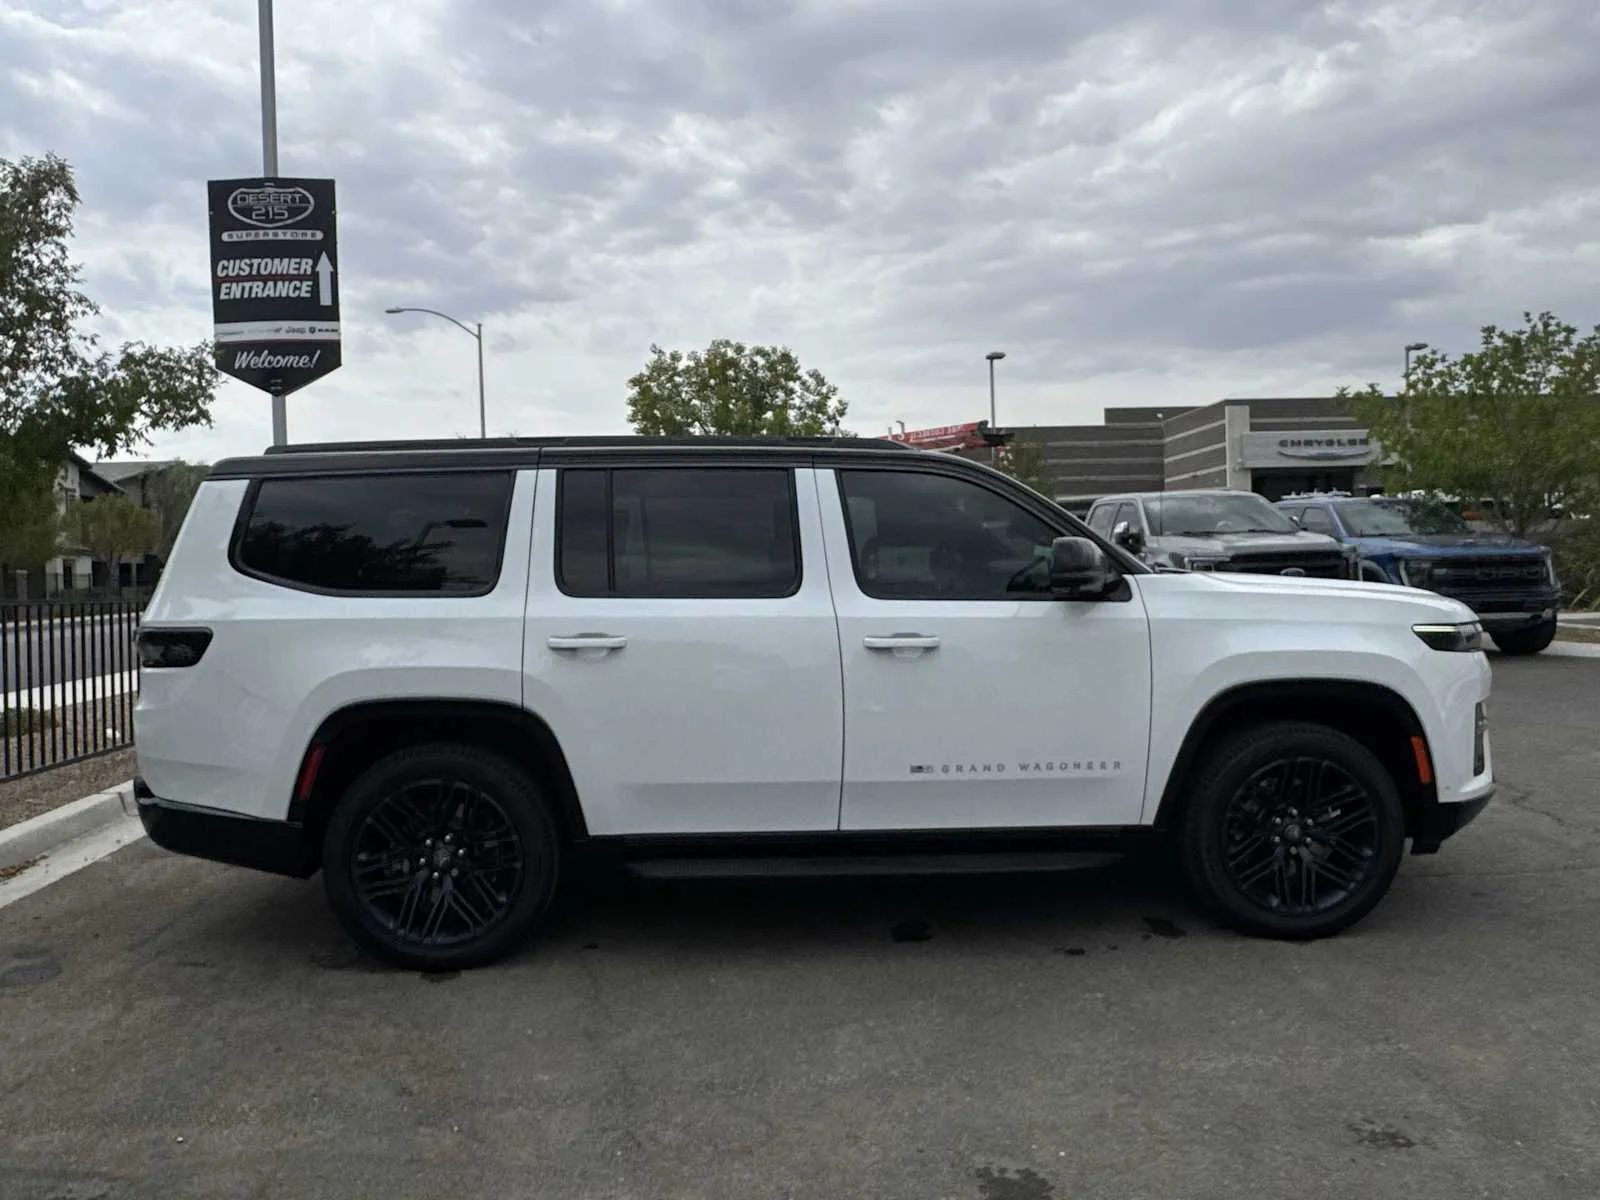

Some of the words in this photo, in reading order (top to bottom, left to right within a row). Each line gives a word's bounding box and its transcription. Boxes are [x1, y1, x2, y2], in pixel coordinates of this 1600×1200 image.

[236, 193, 303, 205] DESERT
[252, 206, 288, 220] 215
[227, 231, 317, 239] SUPERSTORE
[216, 257, 313, 277] CUSTOMER
[219, 280, 313, 300] ENTRANCE
[234, 349, 320, 370] Welcome!
[1279, 438, 1369, 447] CHRYSLER
[941, 763, 1005, 773] GRAND
[1018, 761, 1121, 771] WAGONEER
